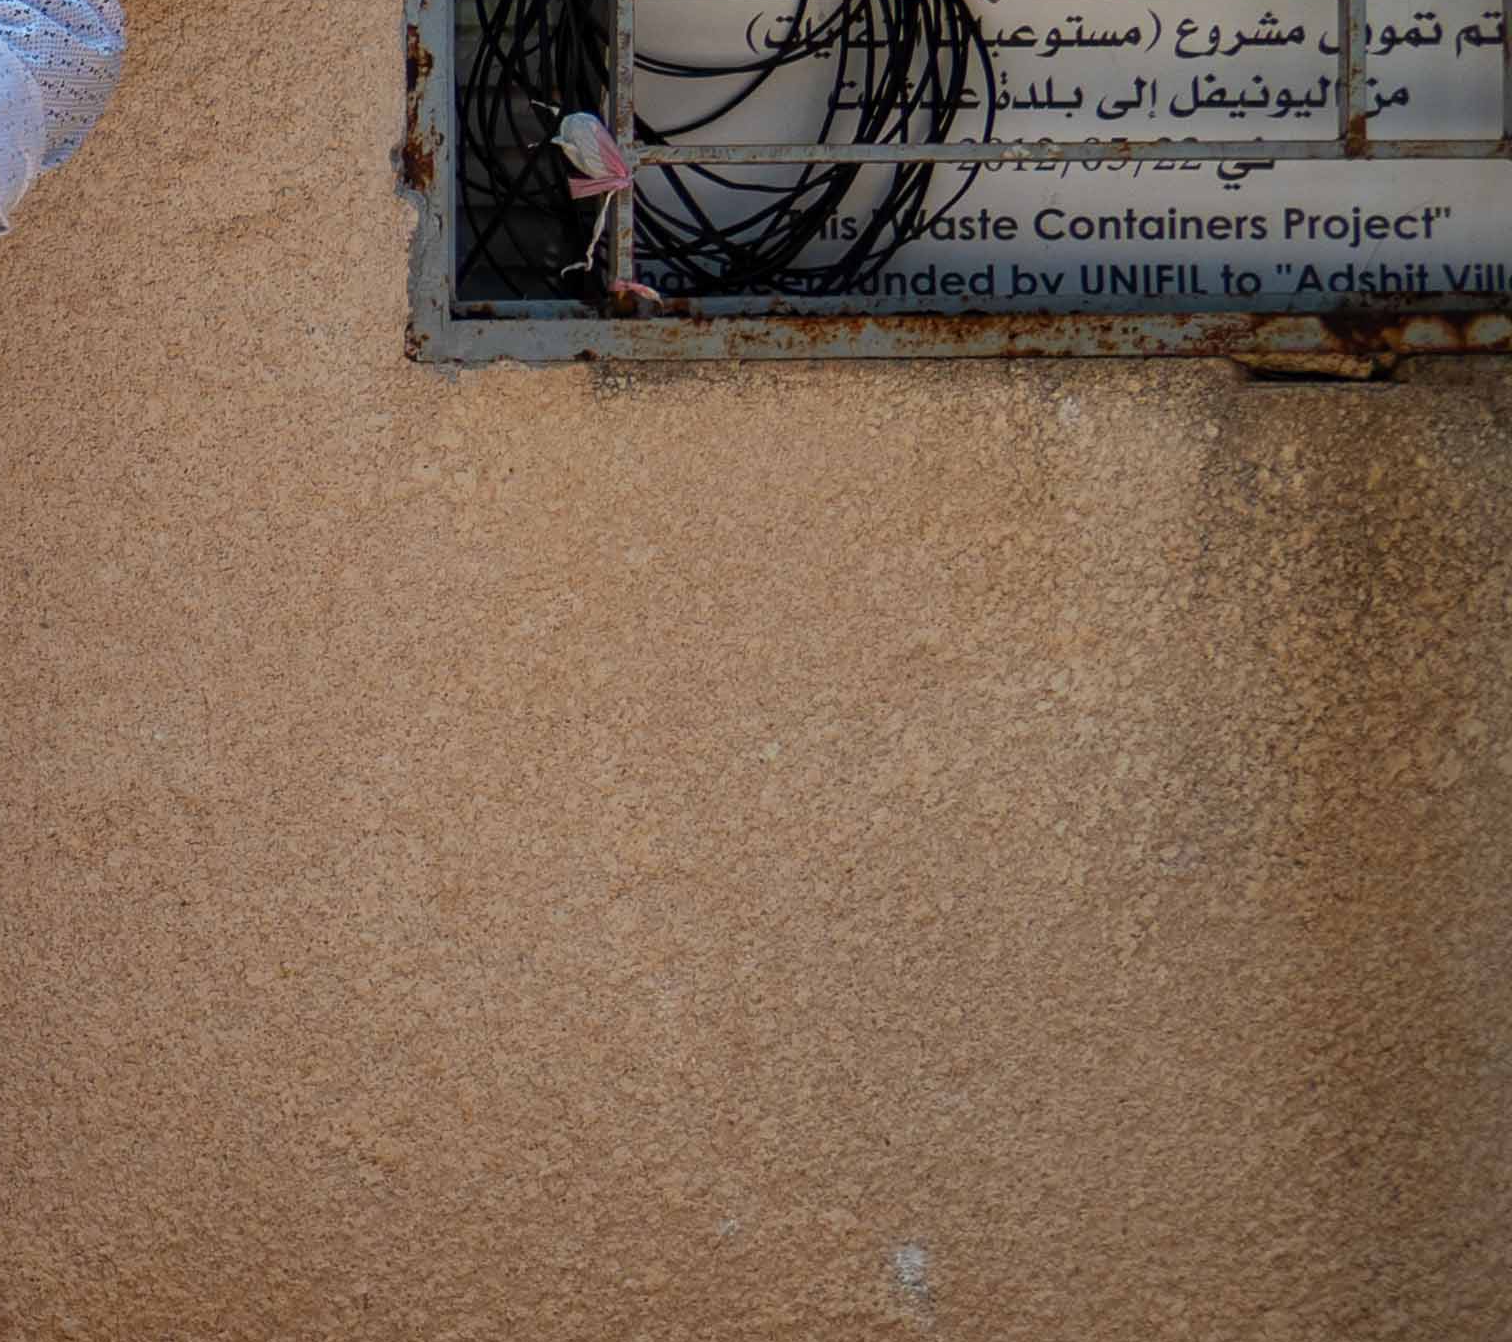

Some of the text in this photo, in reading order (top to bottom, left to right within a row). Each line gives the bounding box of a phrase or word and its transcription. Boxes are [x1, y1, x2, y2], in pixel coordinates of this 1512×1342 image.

[1174, 12, 1306, 58] مشروع
[1097, 74, 1157, 119] إلى
[1034, 207, 1451, 247] Containers Project"
[1080, 264, 1208, 295] UNIFIL
[1221, 264, 1261, 295] to
